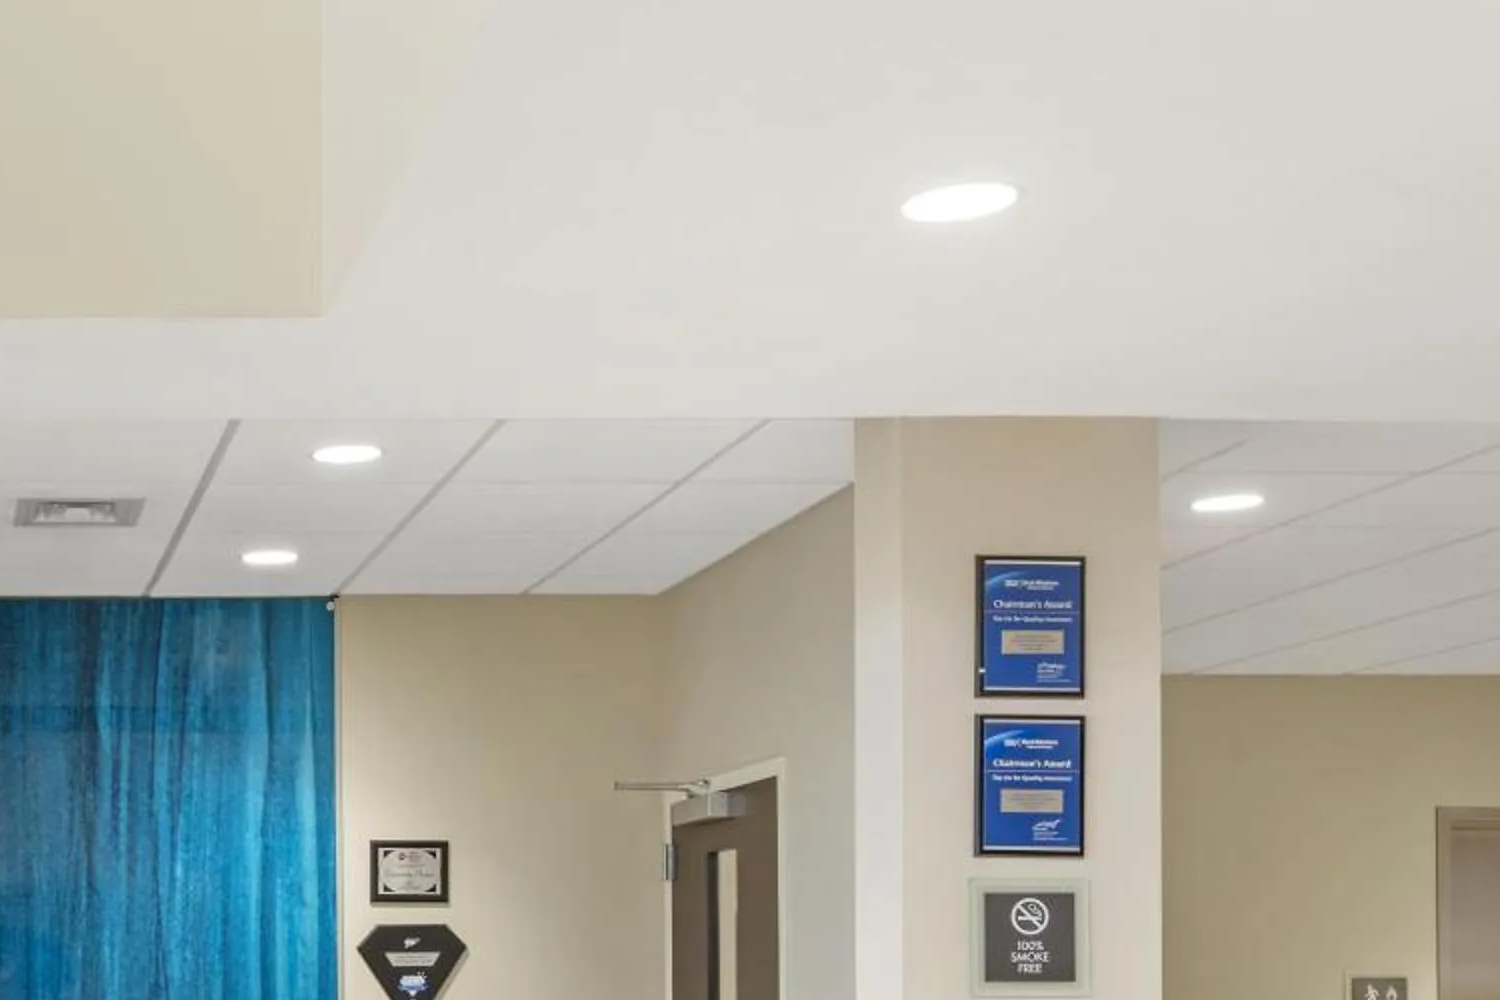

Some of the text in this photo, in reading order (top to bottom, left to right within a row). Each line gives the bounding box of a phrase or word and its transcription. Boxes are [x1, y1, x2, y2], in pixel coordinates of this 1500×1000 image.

[1043, 759, 1072, 769] Award
[1017, 940, 1045, 951] 100%
[1011, 951, 1050, 963] SMOKE
[1017, 963, 1043, 973] FREE
